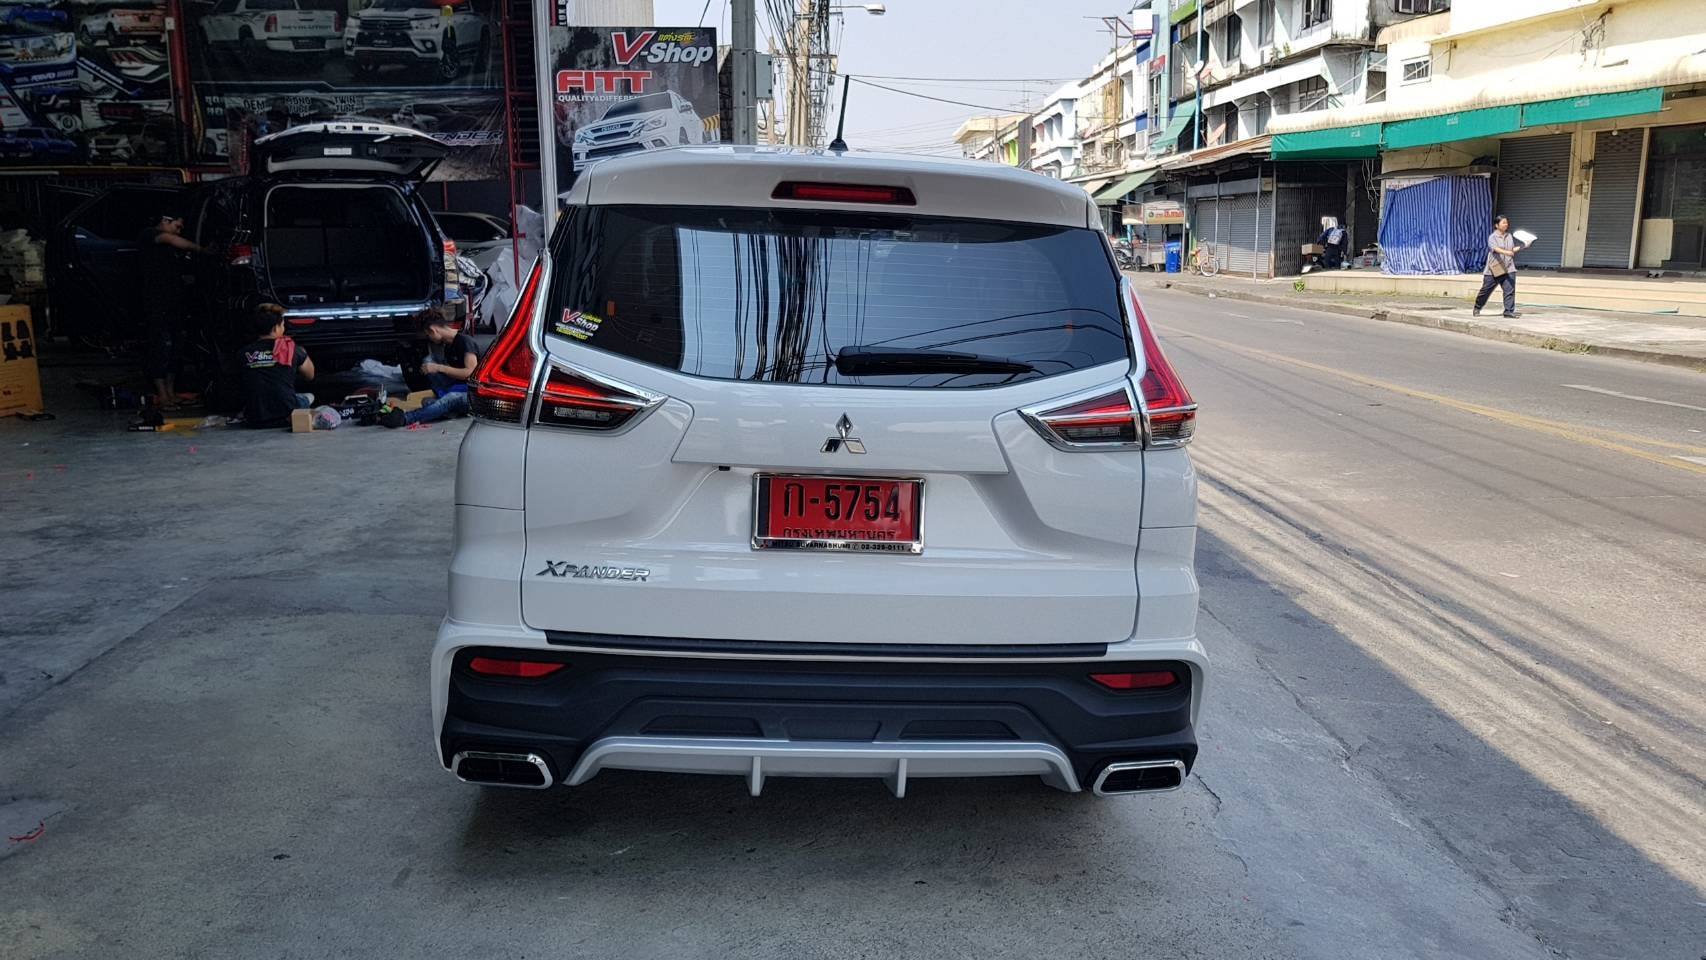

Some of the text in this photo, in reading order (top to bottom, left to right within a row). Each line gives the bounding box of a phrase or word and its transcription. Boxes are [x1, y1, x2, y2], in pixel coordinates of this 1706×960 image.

[610, 31, 714, 67] V-Shop
[556, 70, 653, 94] FITT
[245, 350, 273, 363] V-Sho
[783, 527, 896, 540] กรงเทพมหานคร
[535, 560, 651, 582] XPANDER
